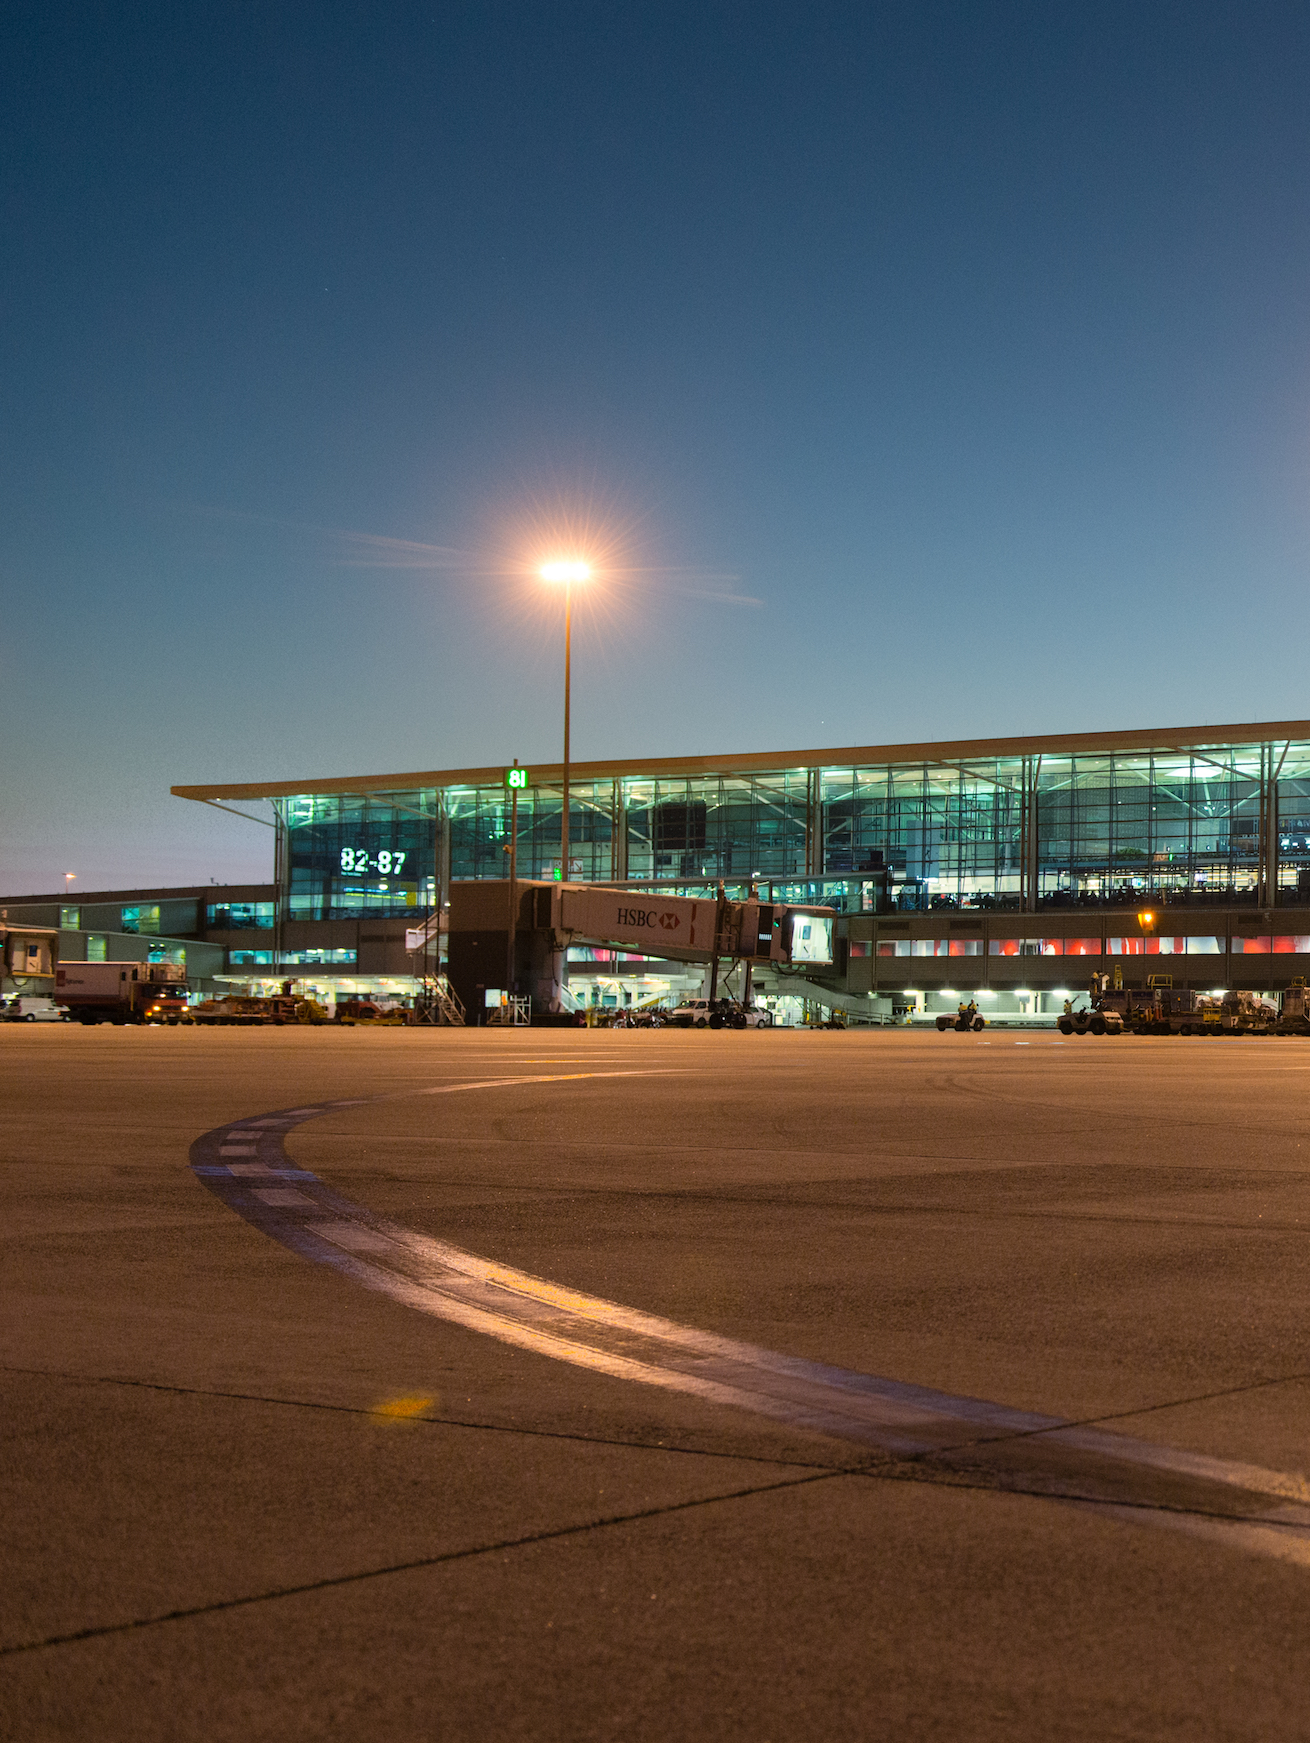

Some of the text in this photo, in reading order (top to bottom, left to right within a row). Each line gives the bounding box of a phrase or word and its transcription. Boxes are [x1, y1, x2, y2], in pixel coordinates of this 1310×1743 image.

[509, 769, 526, 788] 81
[340, 846, 406, 875] 82-87
[617, 907, 657, 928] HSBC
